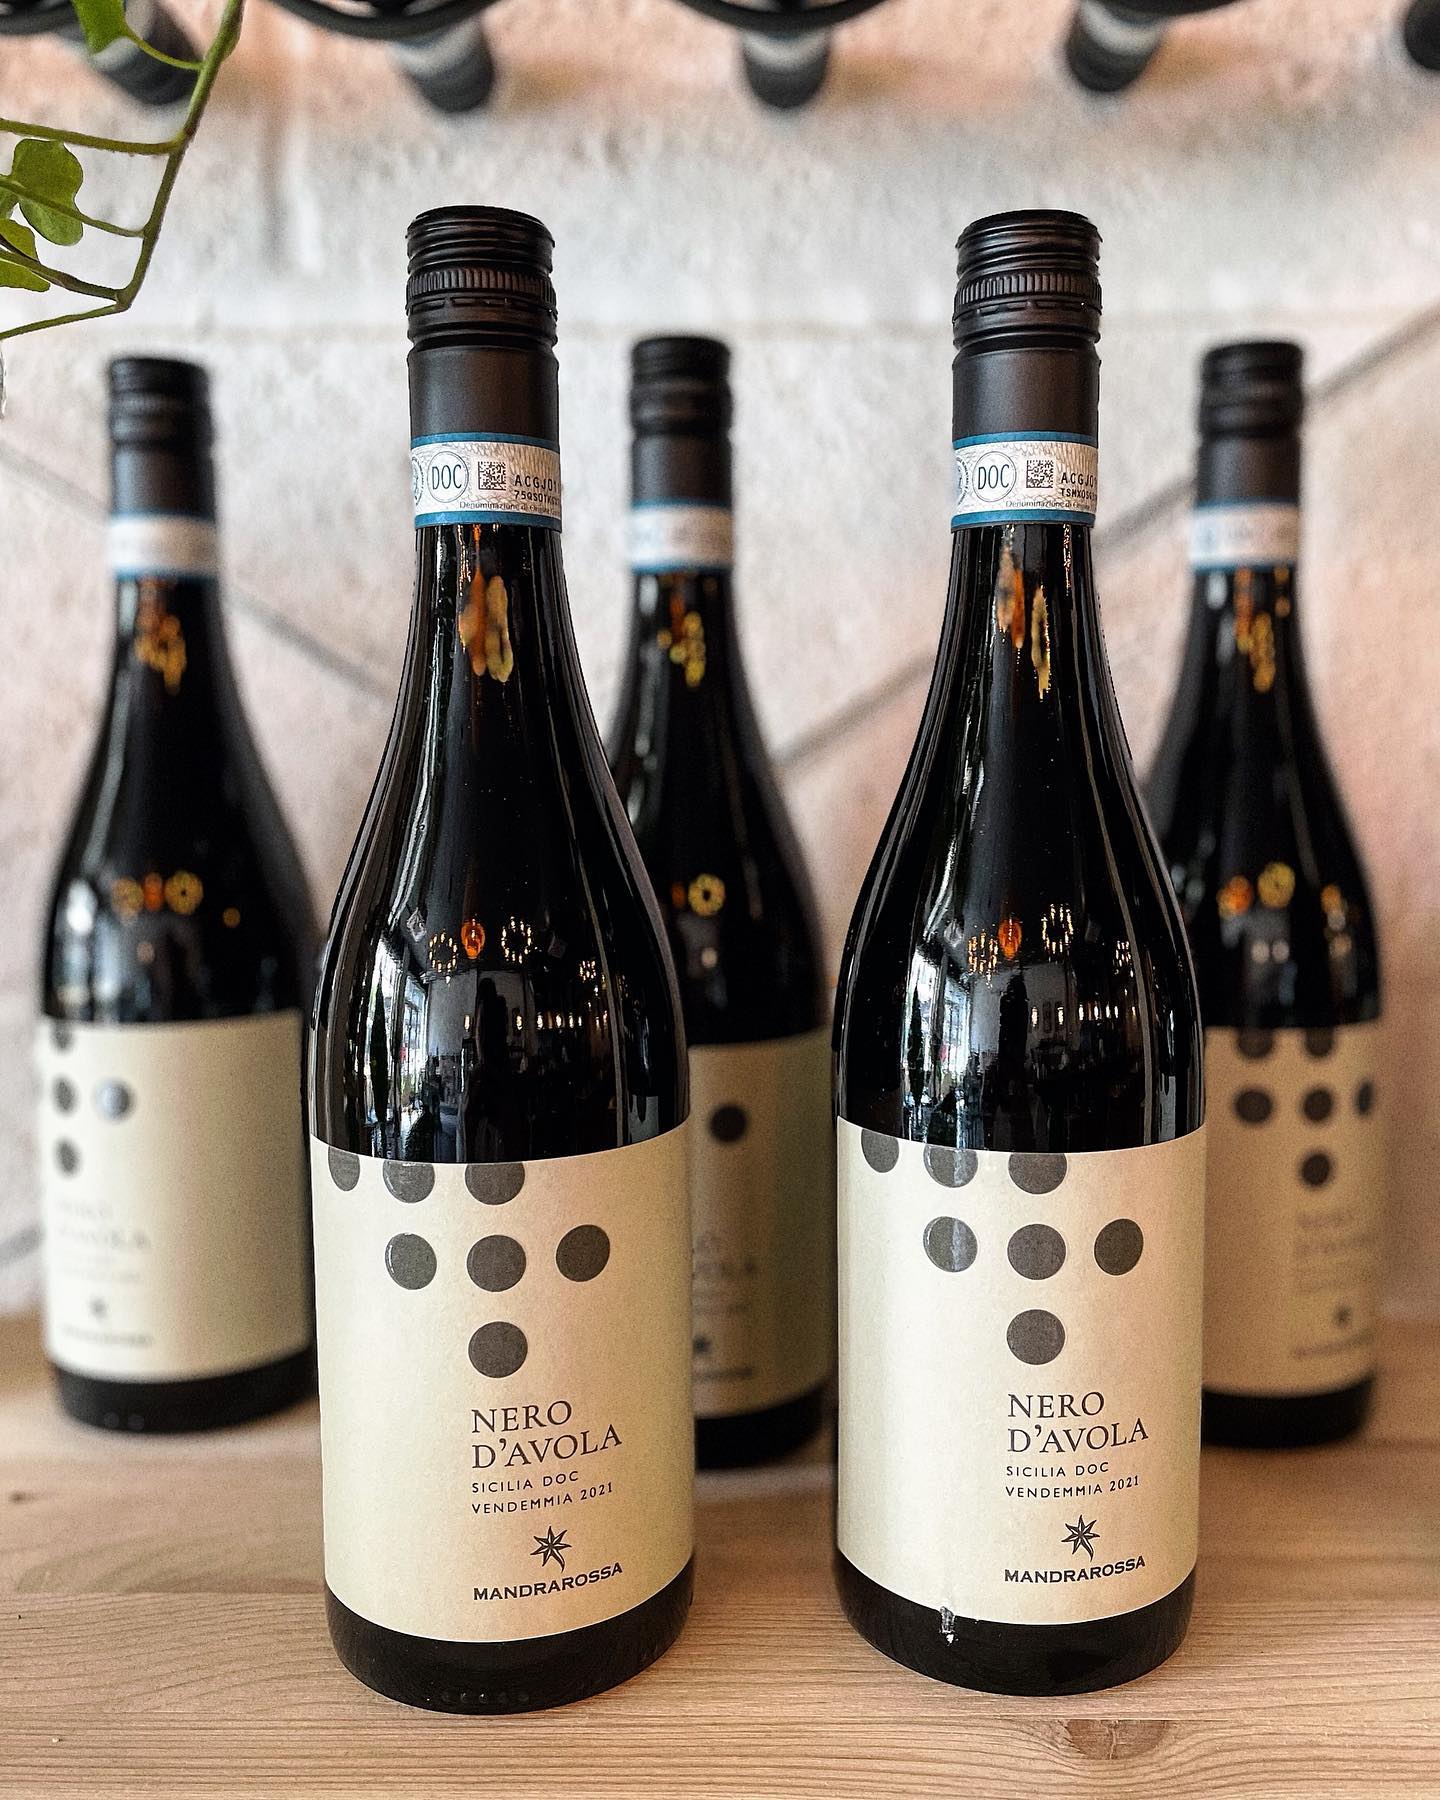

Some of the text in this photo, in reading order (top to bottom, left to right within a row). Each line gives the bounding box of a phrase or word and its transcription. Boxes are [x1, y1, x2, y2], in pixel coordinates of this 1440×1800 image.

[432, 464, 462, 490] DOC
[977, 464, 1010, 490] DOC
[471, 1400, 572, 1433] NERO
[1008, 1391, 1105, 1419] NERO
[471, 1424, 623, 1469] D'AVOLA
[1007, 1417, 1149, 1453] D'AVOLA
[471, 1470, 579, 1494] SICILIA DOC
[1006, 1461, 1109, 1478] SICILIA DOC
[471, 1481, 613, 1515] VENDEMMIA 2021
[1005, 1475, 1139, 1499] VENDEMMIA 2021
[473, 1562, 623, 1601] MANDRAROSSA
[1004, 1556, 1146, 1584] MANDRAROSSA
